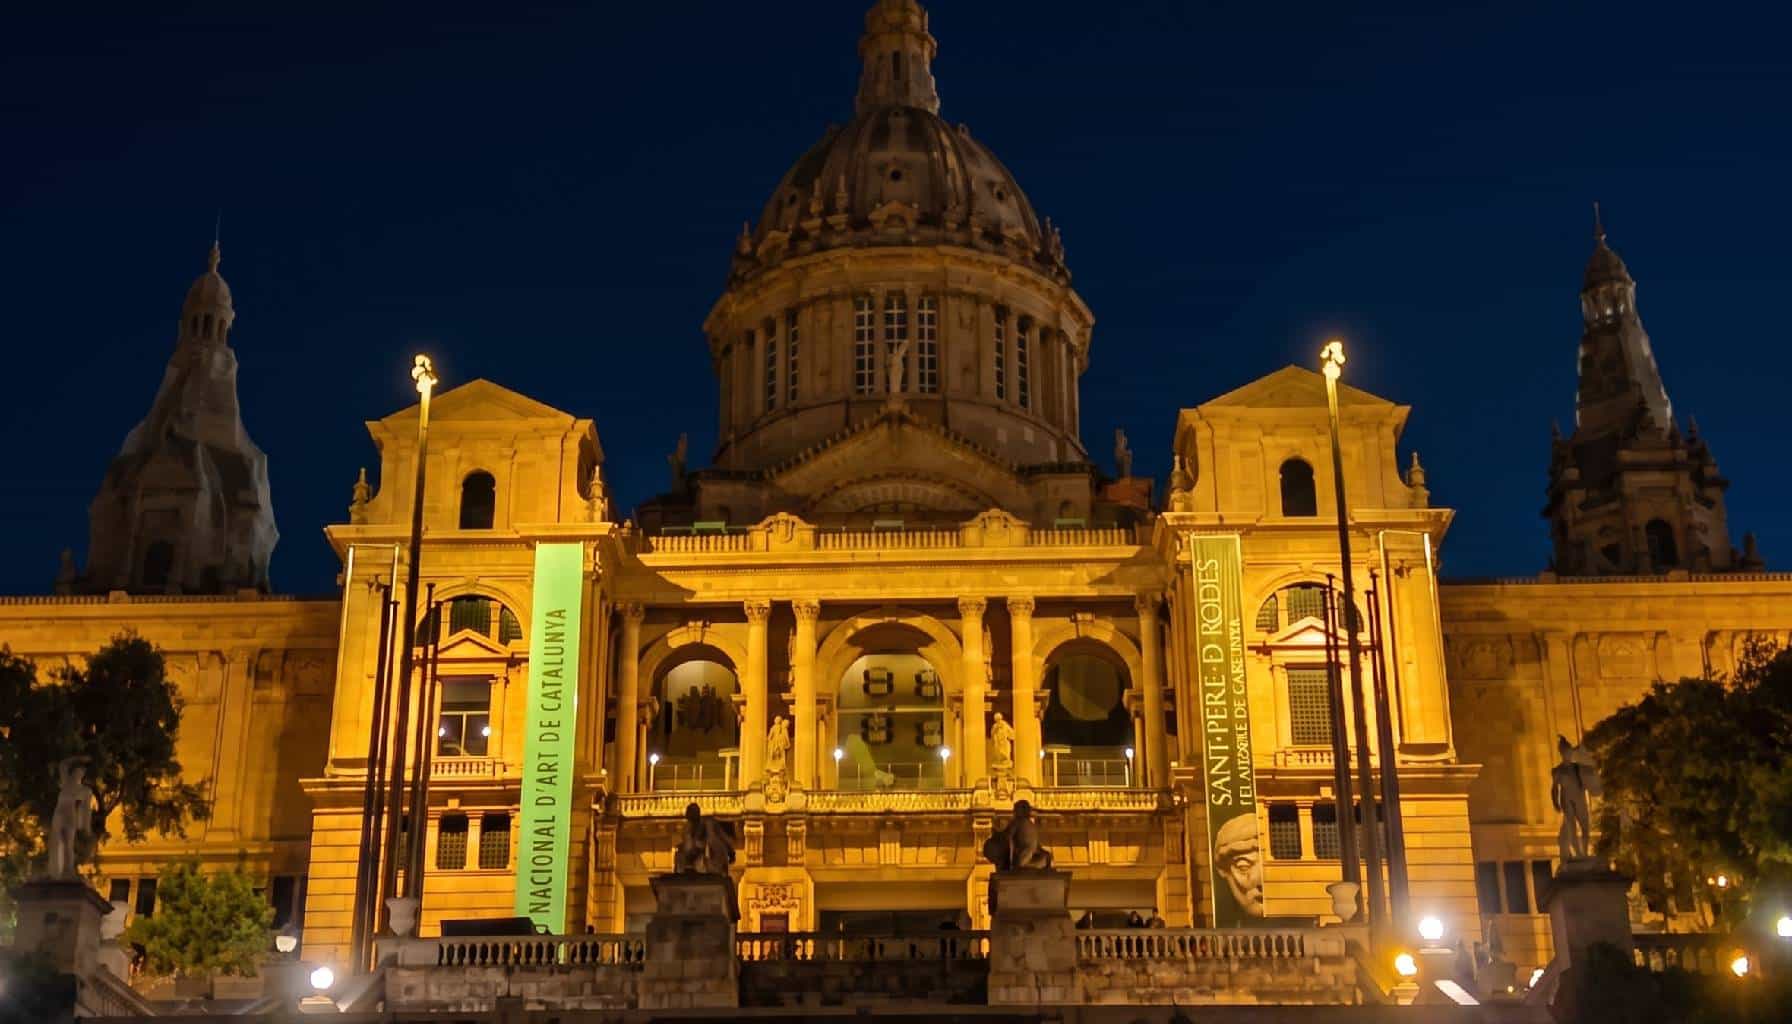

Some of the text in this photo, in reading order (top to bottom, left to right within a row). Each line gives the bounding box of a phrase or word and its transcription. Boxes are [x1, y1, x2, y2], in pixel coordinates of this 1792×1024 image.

[1197, 559, 1222, 635] RODES
[541, 609, 566, 712] CATALUNYA
[539, 720, 560, 742] DE
[535, 752, 558, 806] D'ART
[529, 815, 555, 914] NACIONAL
